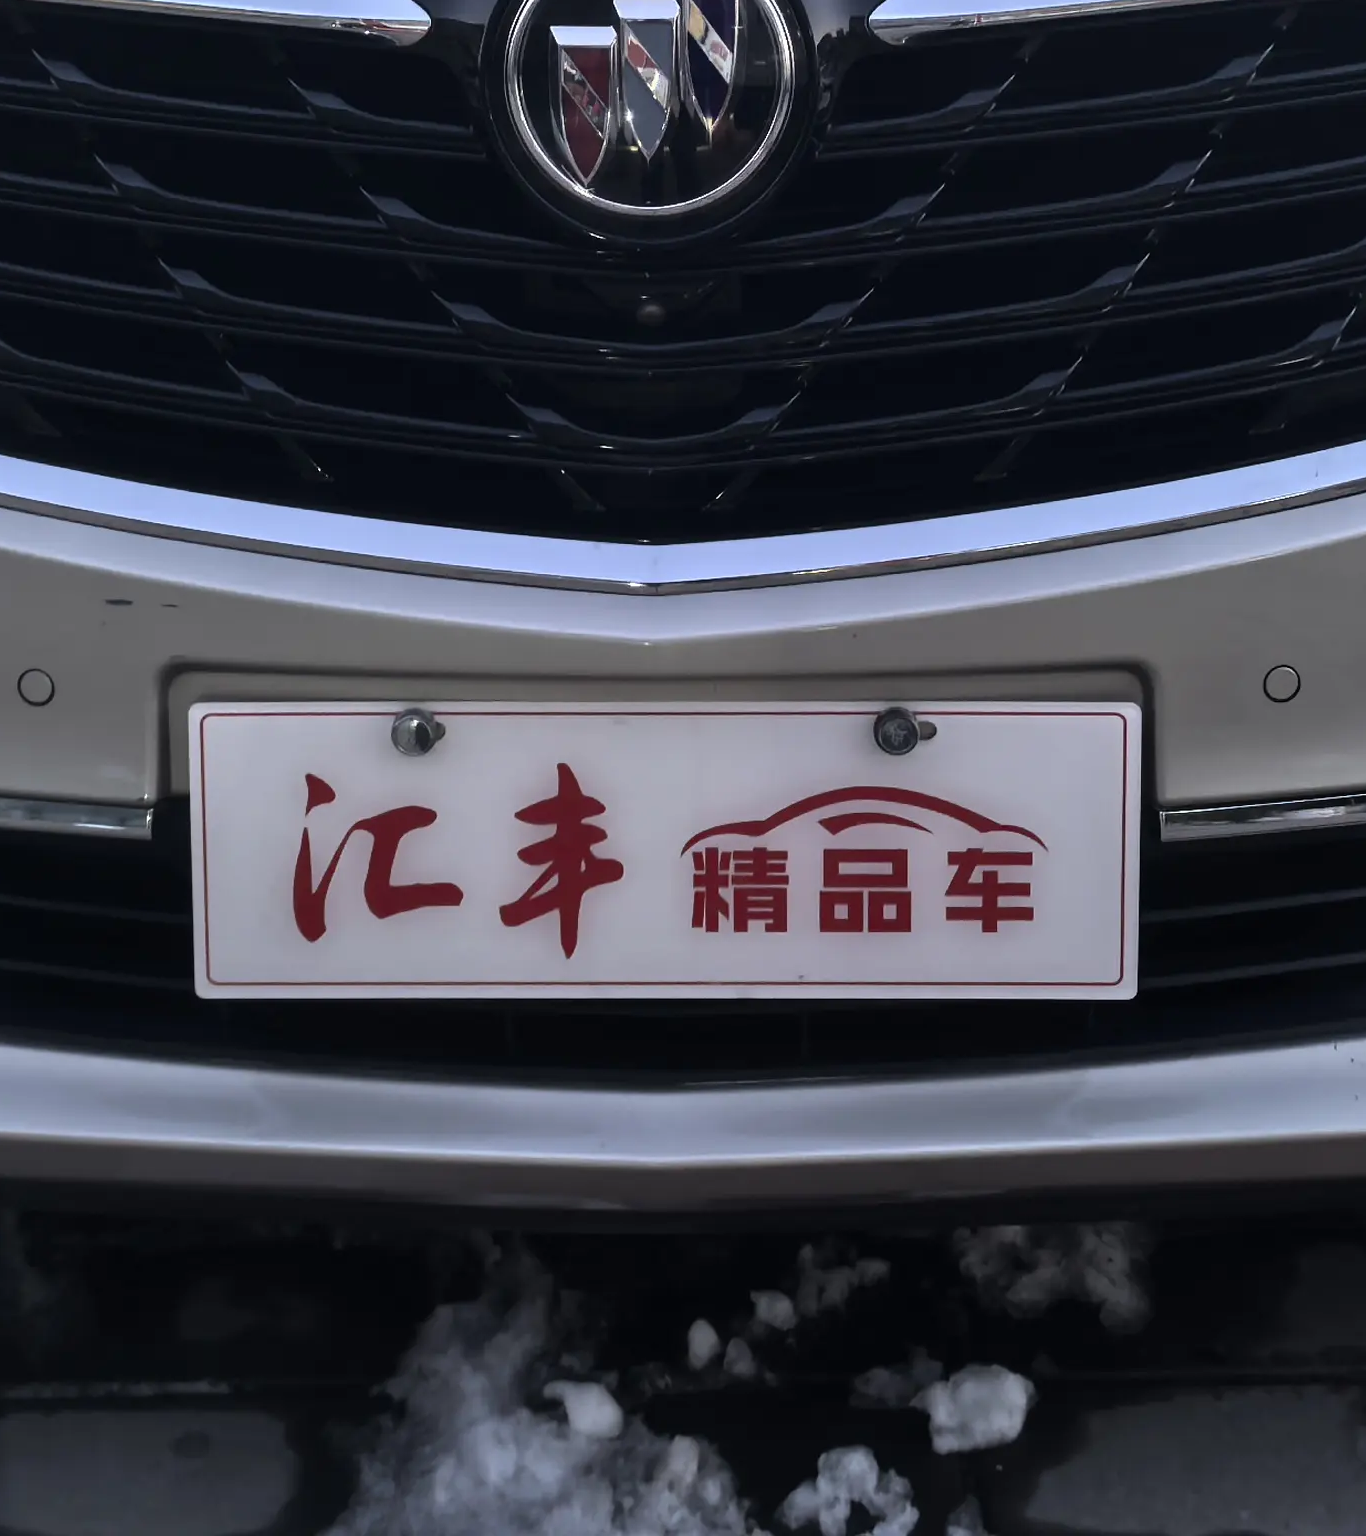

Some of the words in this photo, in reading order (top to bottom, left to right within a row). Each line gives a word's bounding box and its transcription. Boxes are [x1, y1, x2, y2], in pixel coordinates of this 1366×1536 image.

[293, 762, 625, 959] 汇丰
[691, 848, 1034, 934] 精品车
